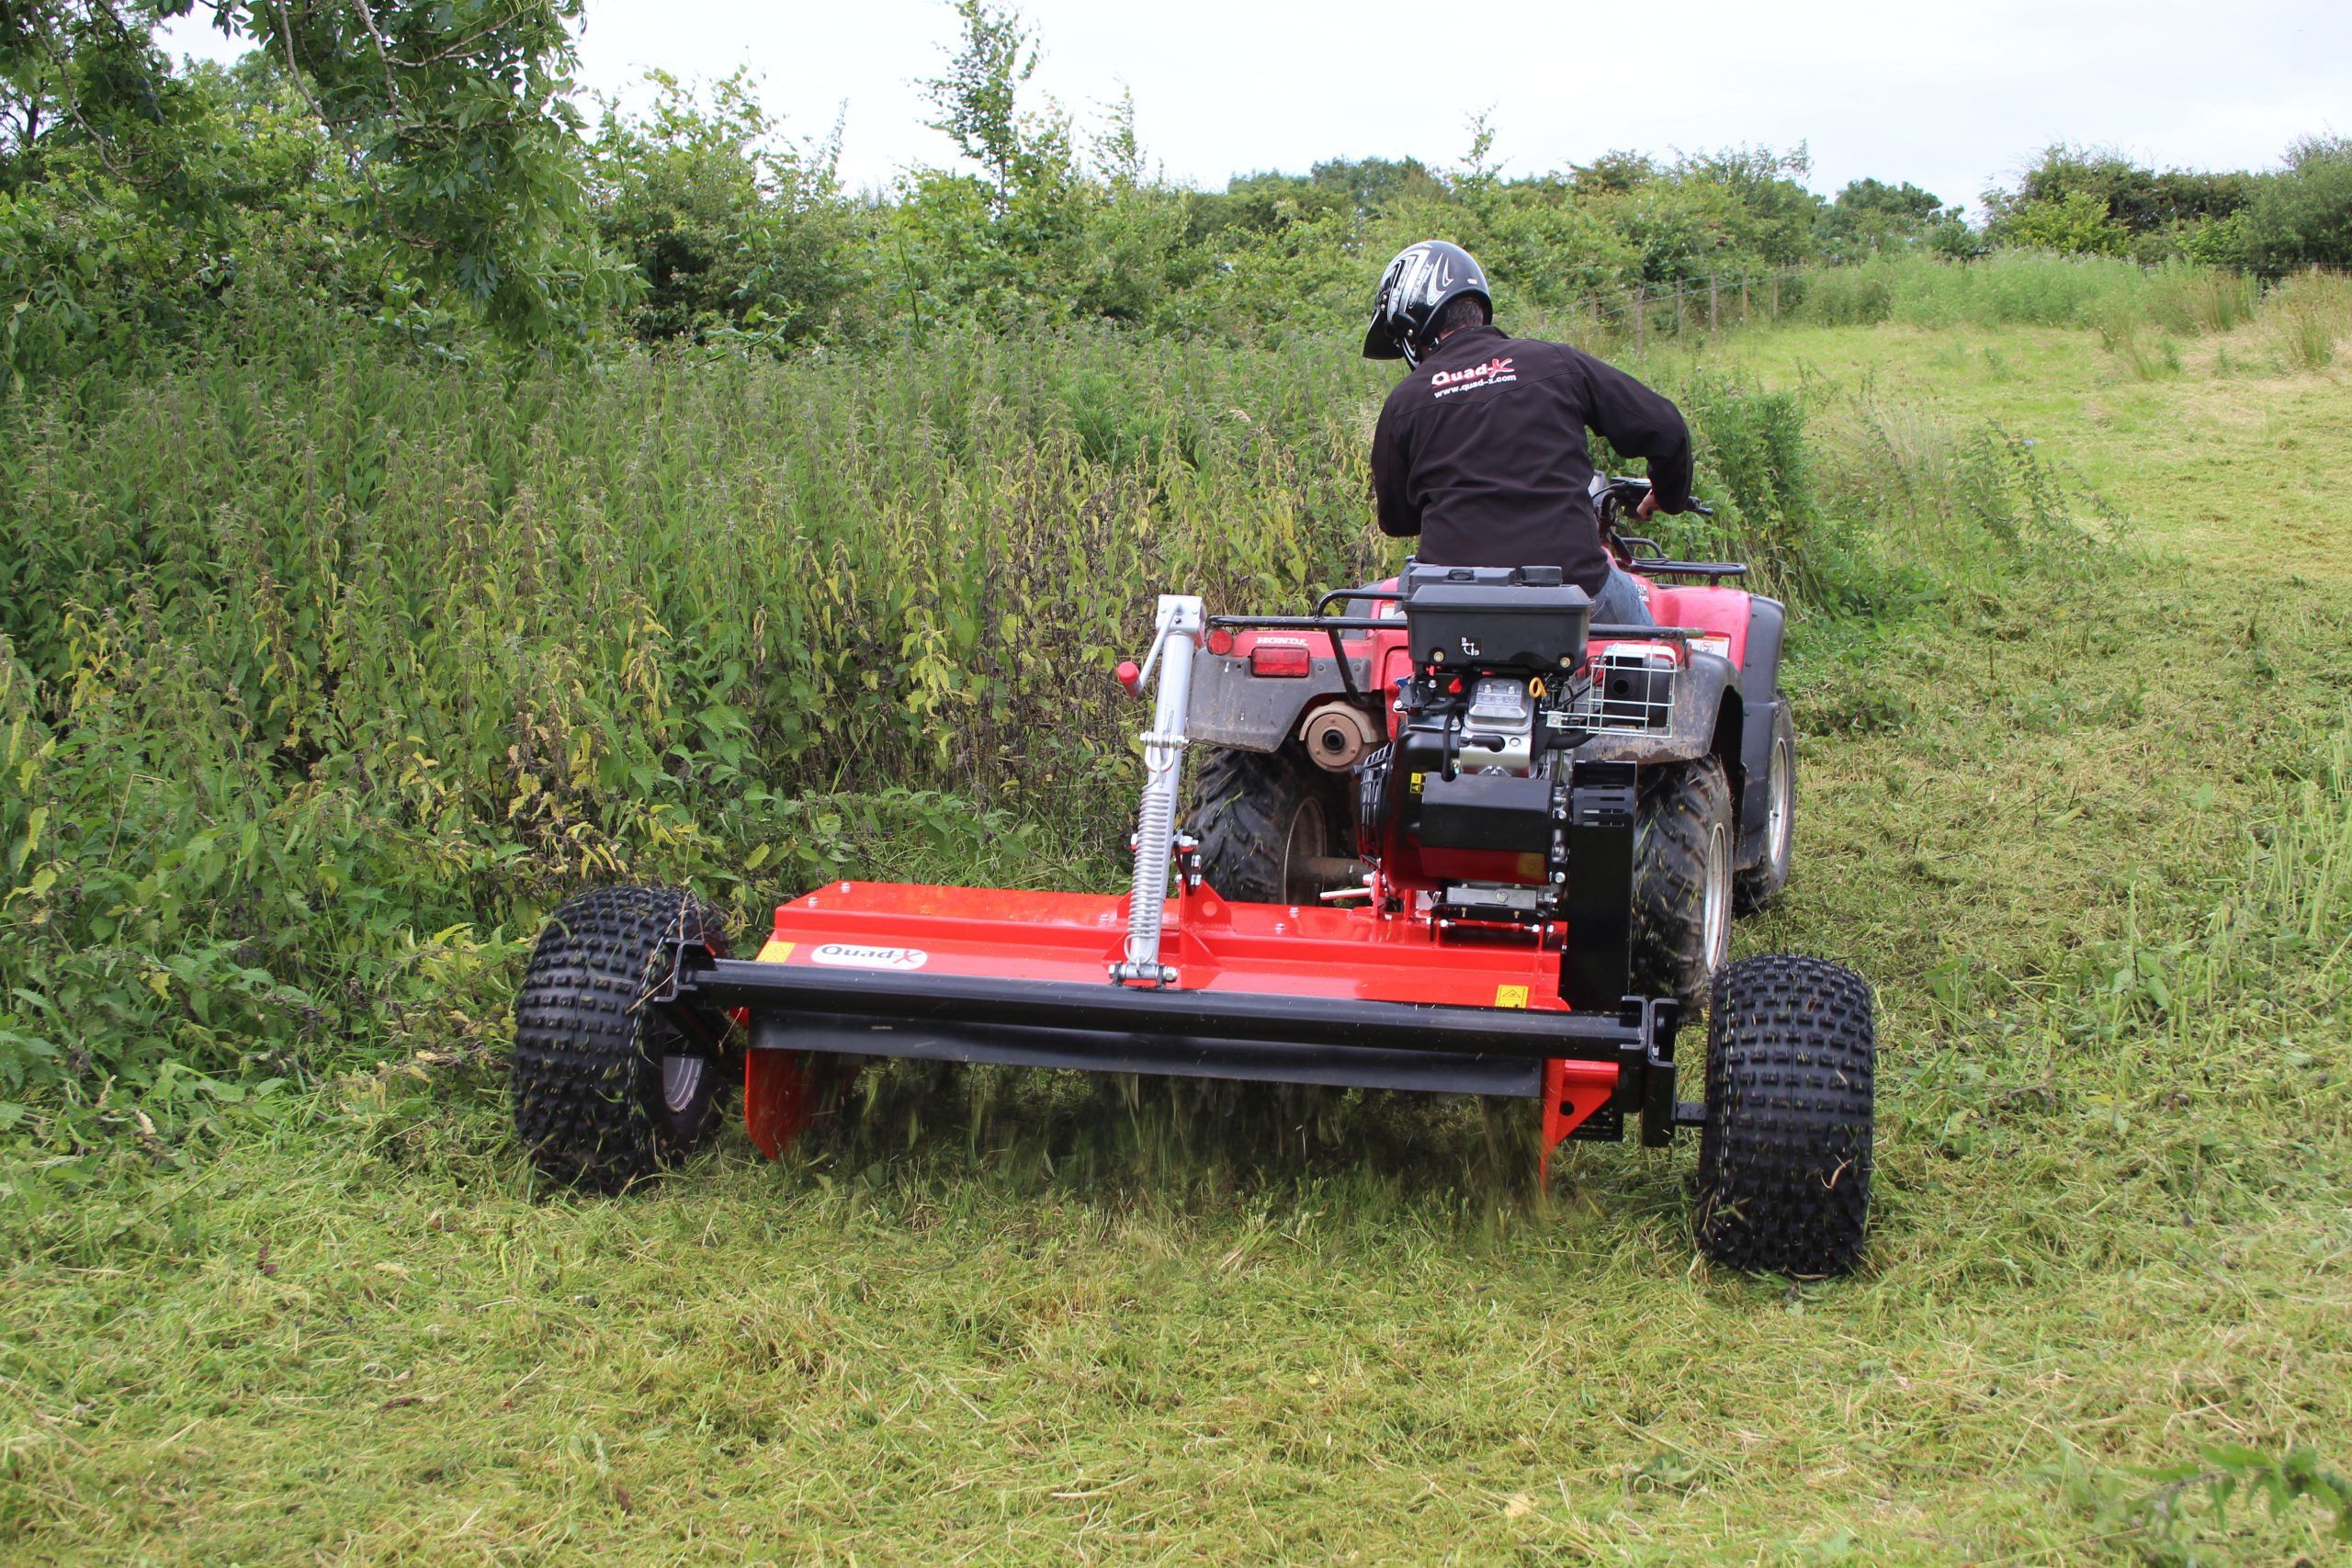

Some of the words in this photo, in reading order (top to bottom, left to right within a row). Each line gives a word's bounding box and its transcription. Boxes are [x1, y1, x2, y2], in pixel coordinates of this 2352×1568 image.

[1433, 374, 1517, 399] www.quad-x.com
[1256, 637, 1309, 647] HONDA
[820, 945, 922, 964] Quad-X
